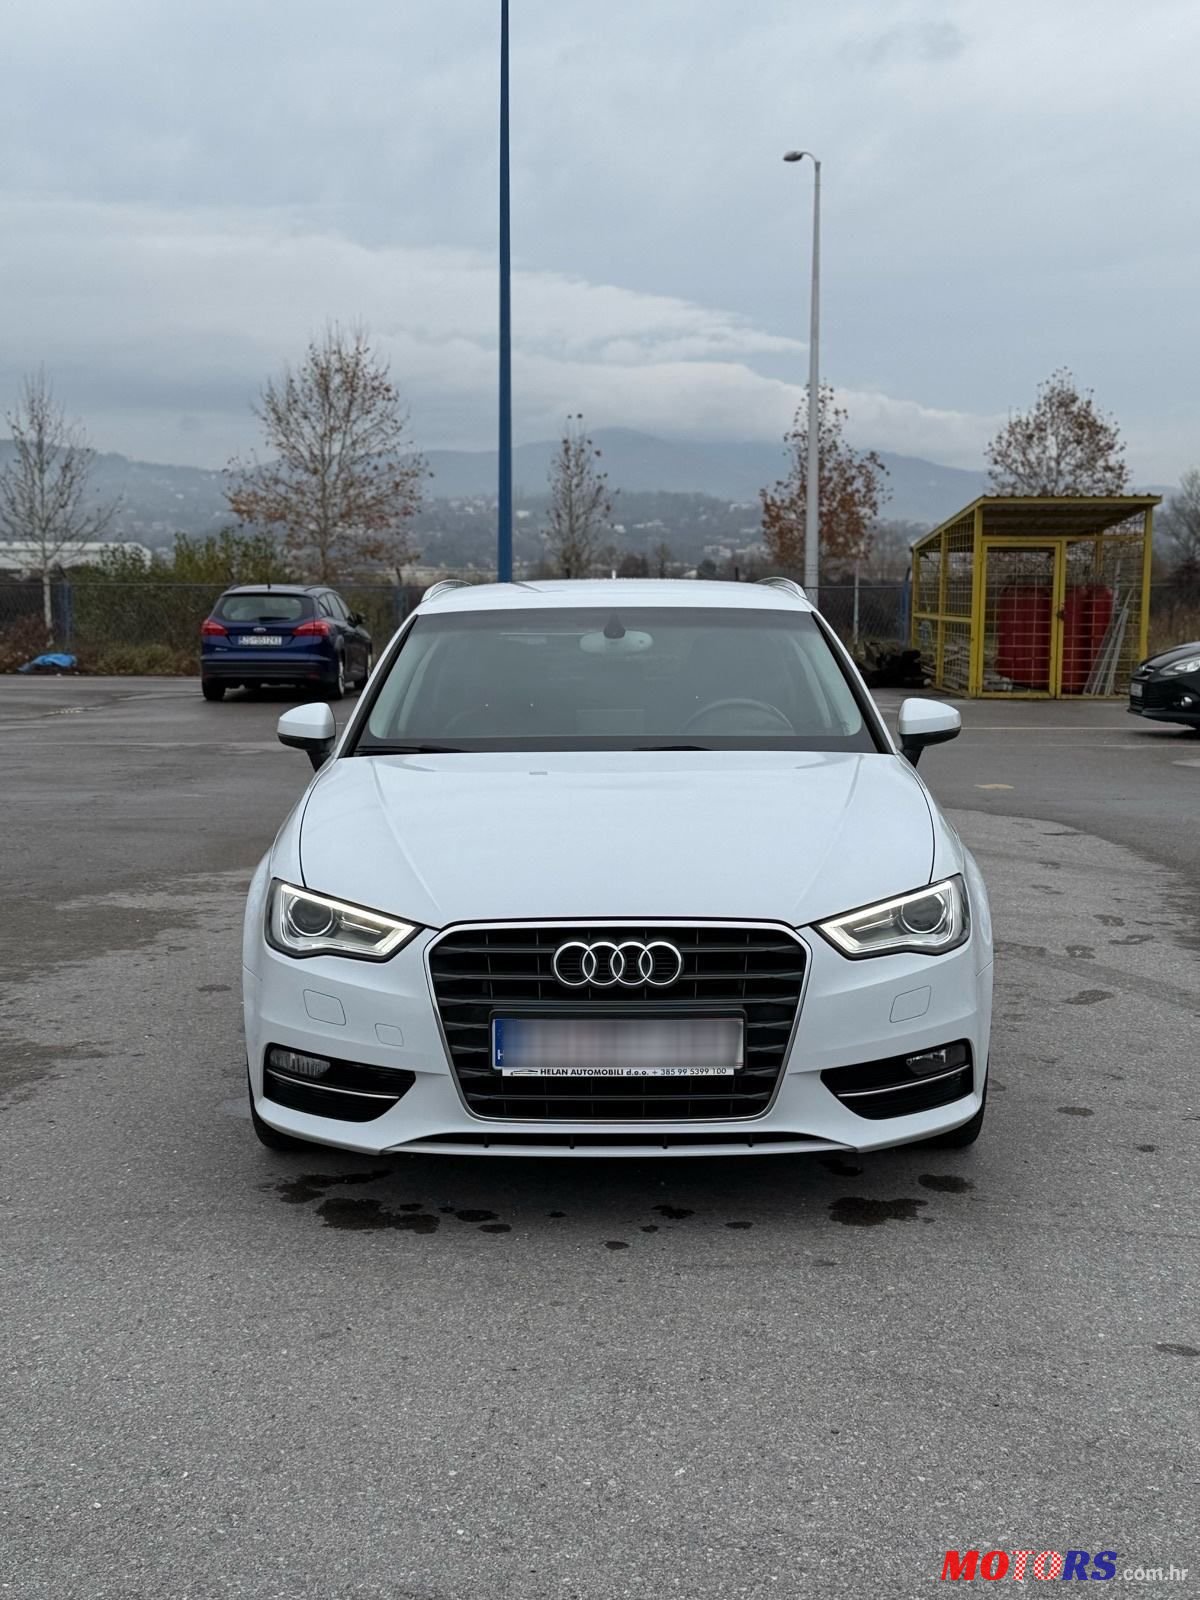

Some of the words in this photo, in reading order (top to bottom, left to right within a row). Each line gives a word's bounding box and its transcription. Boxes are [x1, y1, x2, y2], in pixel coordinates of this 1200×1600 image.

[540, 1068, 568, 1076] HELAN
[570, 1068, 624, 1076] AUTOMOBILI
[626, 1068, 649, 1076] d.o.o.
[660, 1068, 676, 1076] 385
[690, 1067, 709, 1075] 5399
[712, 1067, 727, 1075] 100
